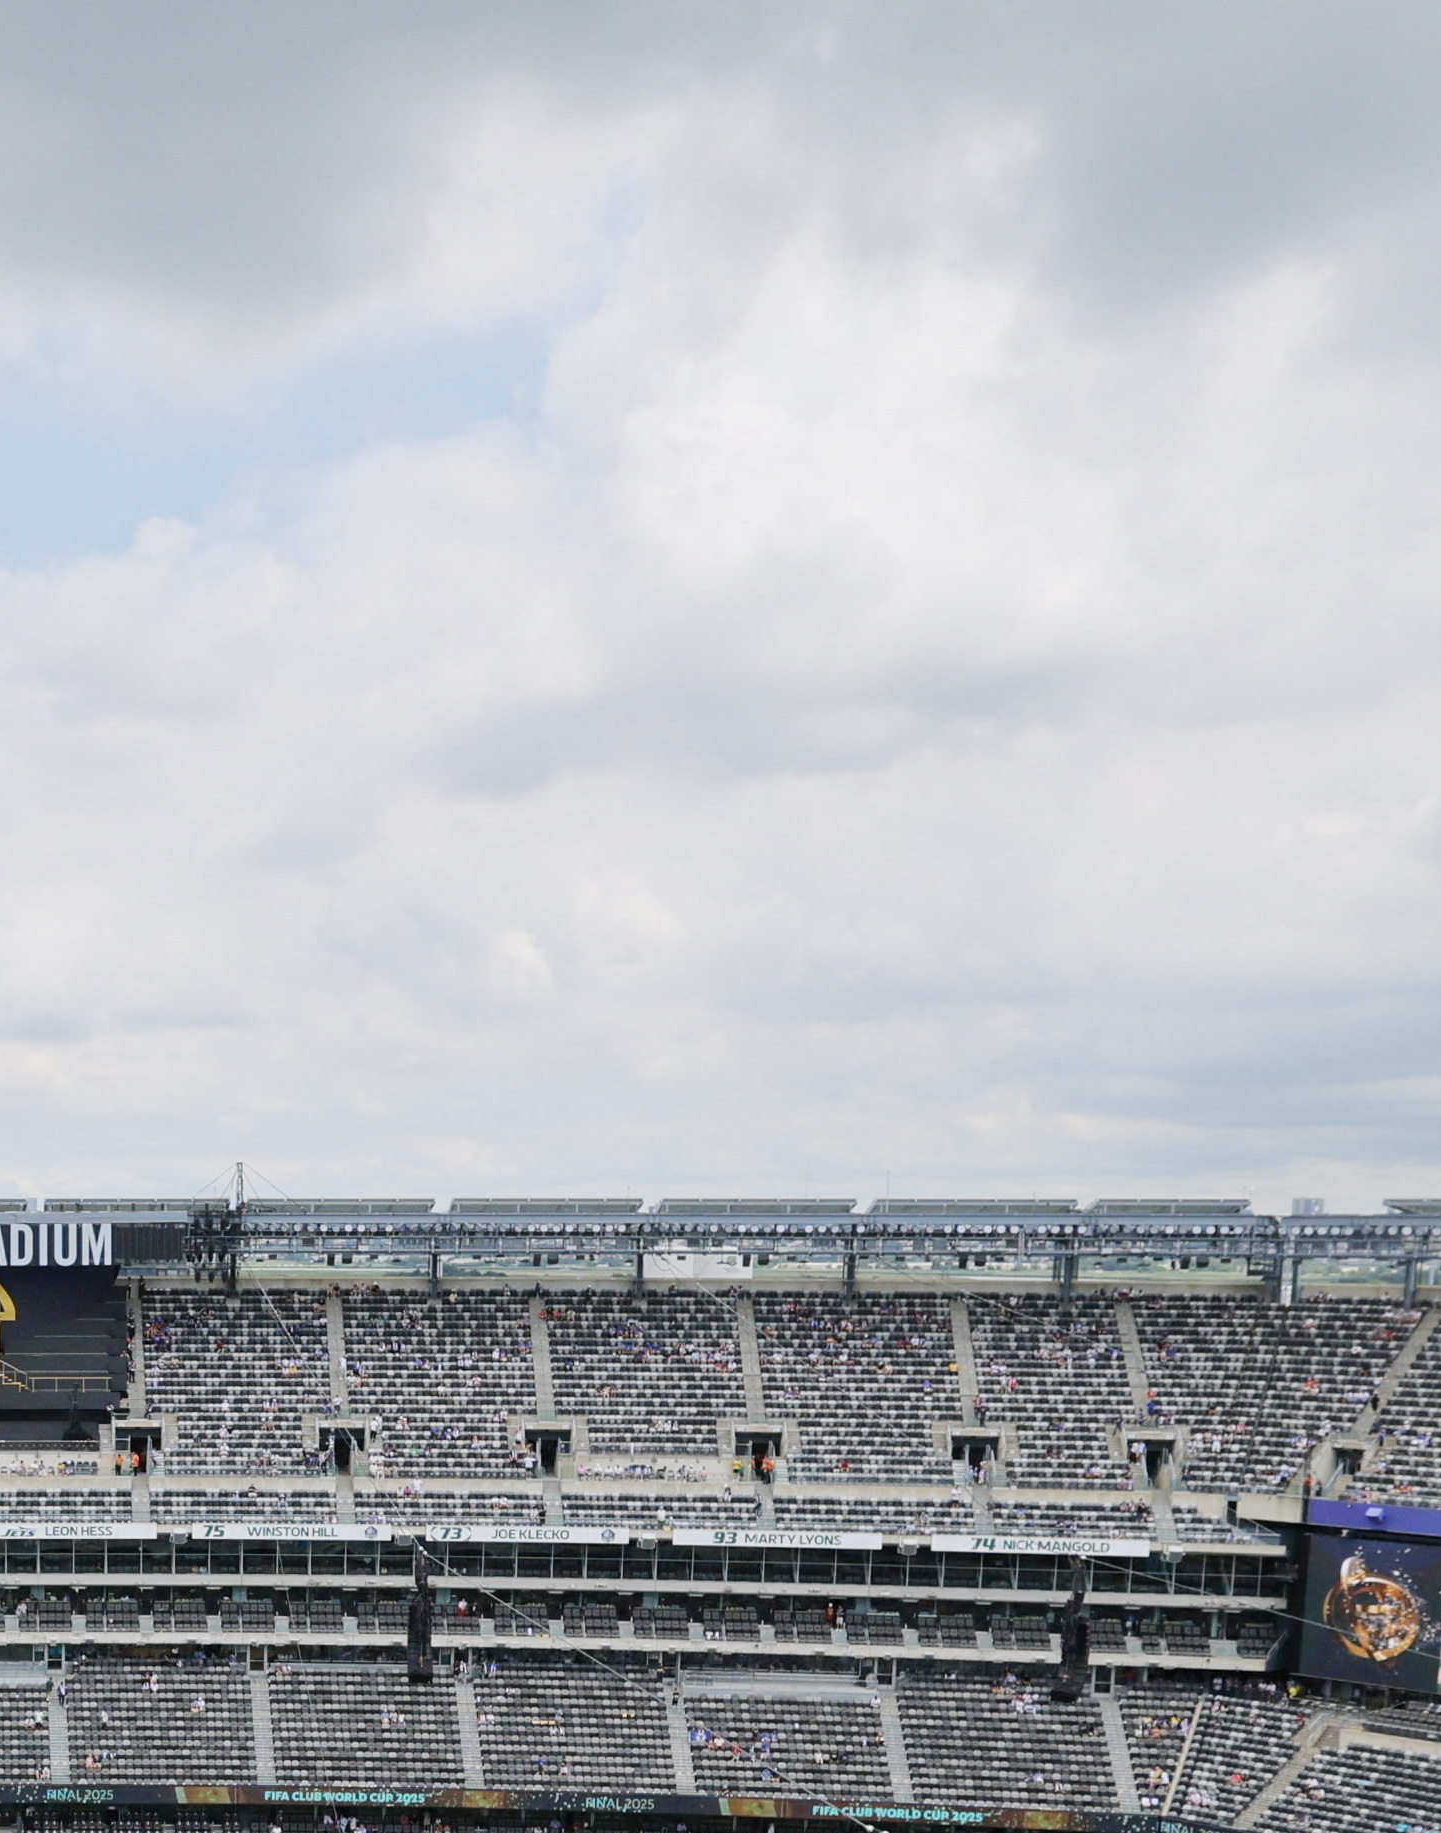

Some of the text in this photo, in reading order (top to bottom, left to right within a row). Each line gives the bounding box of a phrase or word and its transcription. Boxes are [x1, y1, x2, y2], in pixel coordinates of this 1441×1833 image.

[45, 1526, 112, 1536] LEON HESS
[203, 1525, 338, 1537] 75 WINSTON HILL
[441, 1527, 570, 1540] 73 JOE KLECKO
[712, 1531, 842, 1546] 93 MARTY LYONS
[971, 1538, 1110, 1553] 74 NICK MANGOLD
[47, 1789, 114, 1801] FINAL 2025
[264, 1791, 425, 1804] FIFA CLUB WORLD CUP 2025
[585, 1797, 655, 1810] FINAL 2025
[812, 1805, 984, 1824] FIFA CLUB WORLD CUP 2025
